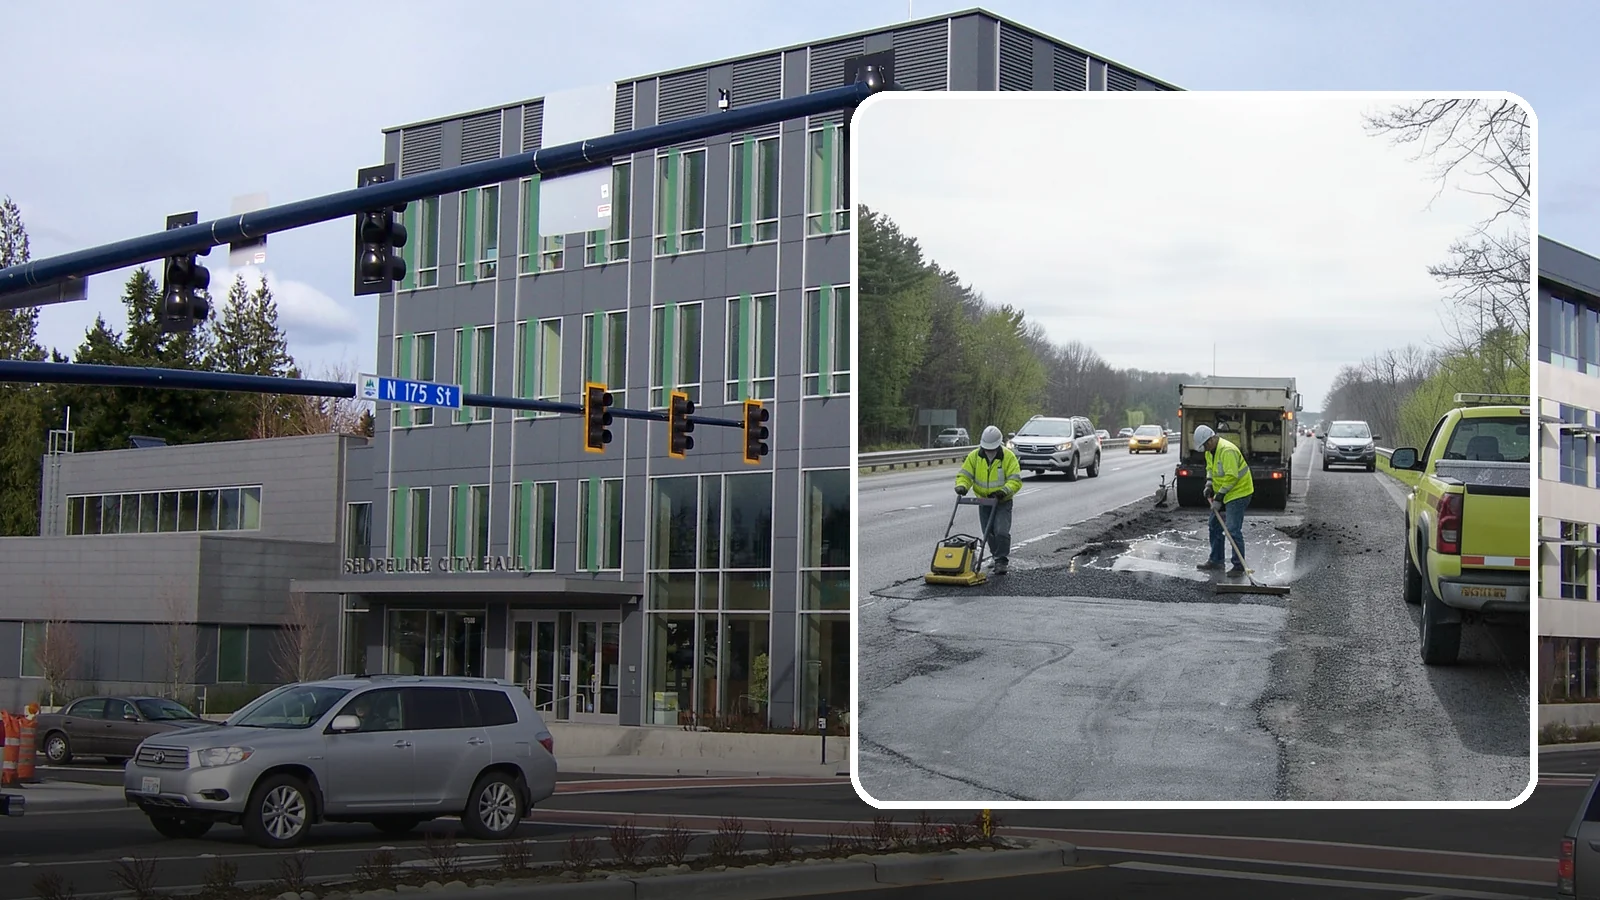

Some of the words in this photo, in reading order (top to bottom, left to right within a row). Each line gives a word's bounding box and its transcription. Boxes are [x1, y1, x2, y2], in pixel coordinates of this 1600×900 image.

[387, 380, 396, 400] N
[405, 382, 428, 403] 175
[436, 386, 452, 406] St
[344, 556, 432, 574] SHORELINE
[438, 556, 476, 572] CITY
[483, 555, 526, 572] HALL
